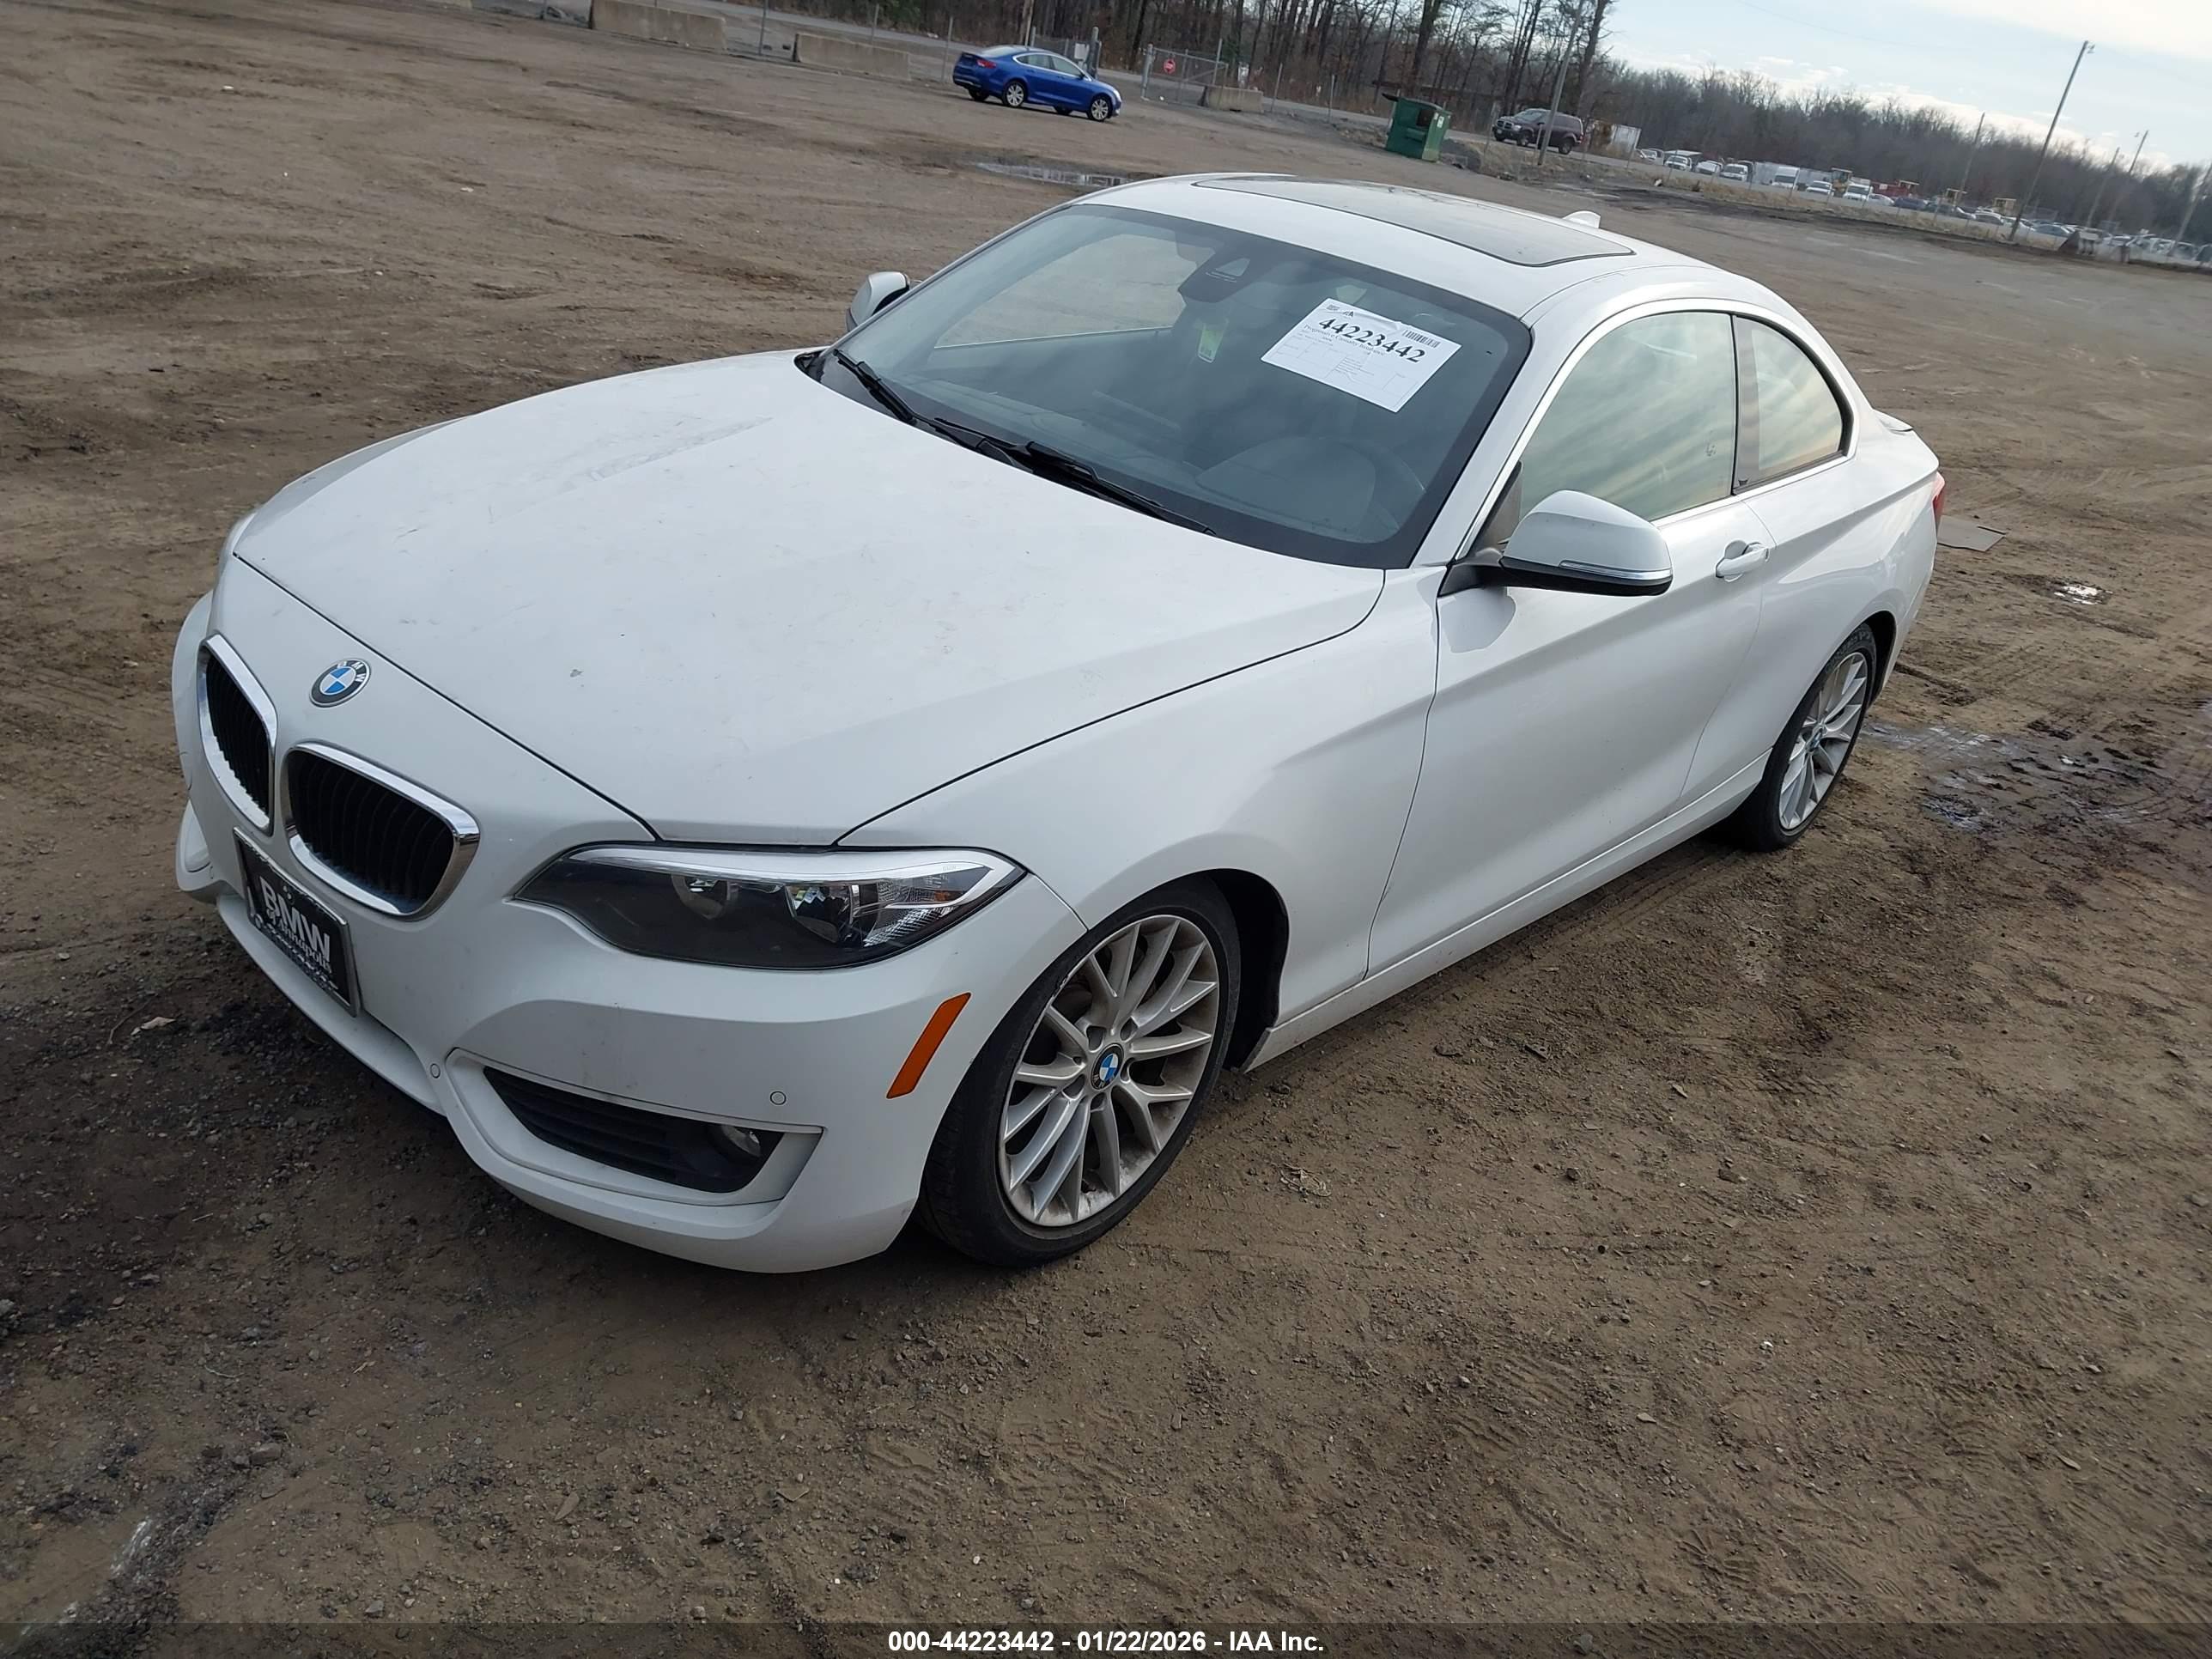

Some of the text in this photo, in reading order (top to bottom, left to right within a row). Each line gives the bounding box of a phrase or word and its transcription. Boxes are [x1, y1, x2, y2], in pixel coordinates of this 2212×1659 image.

[1318, 318, 1426, 363] 44223442
[336, 660, 367, 683] BMW
[259, 875, 331, 963] BMW
